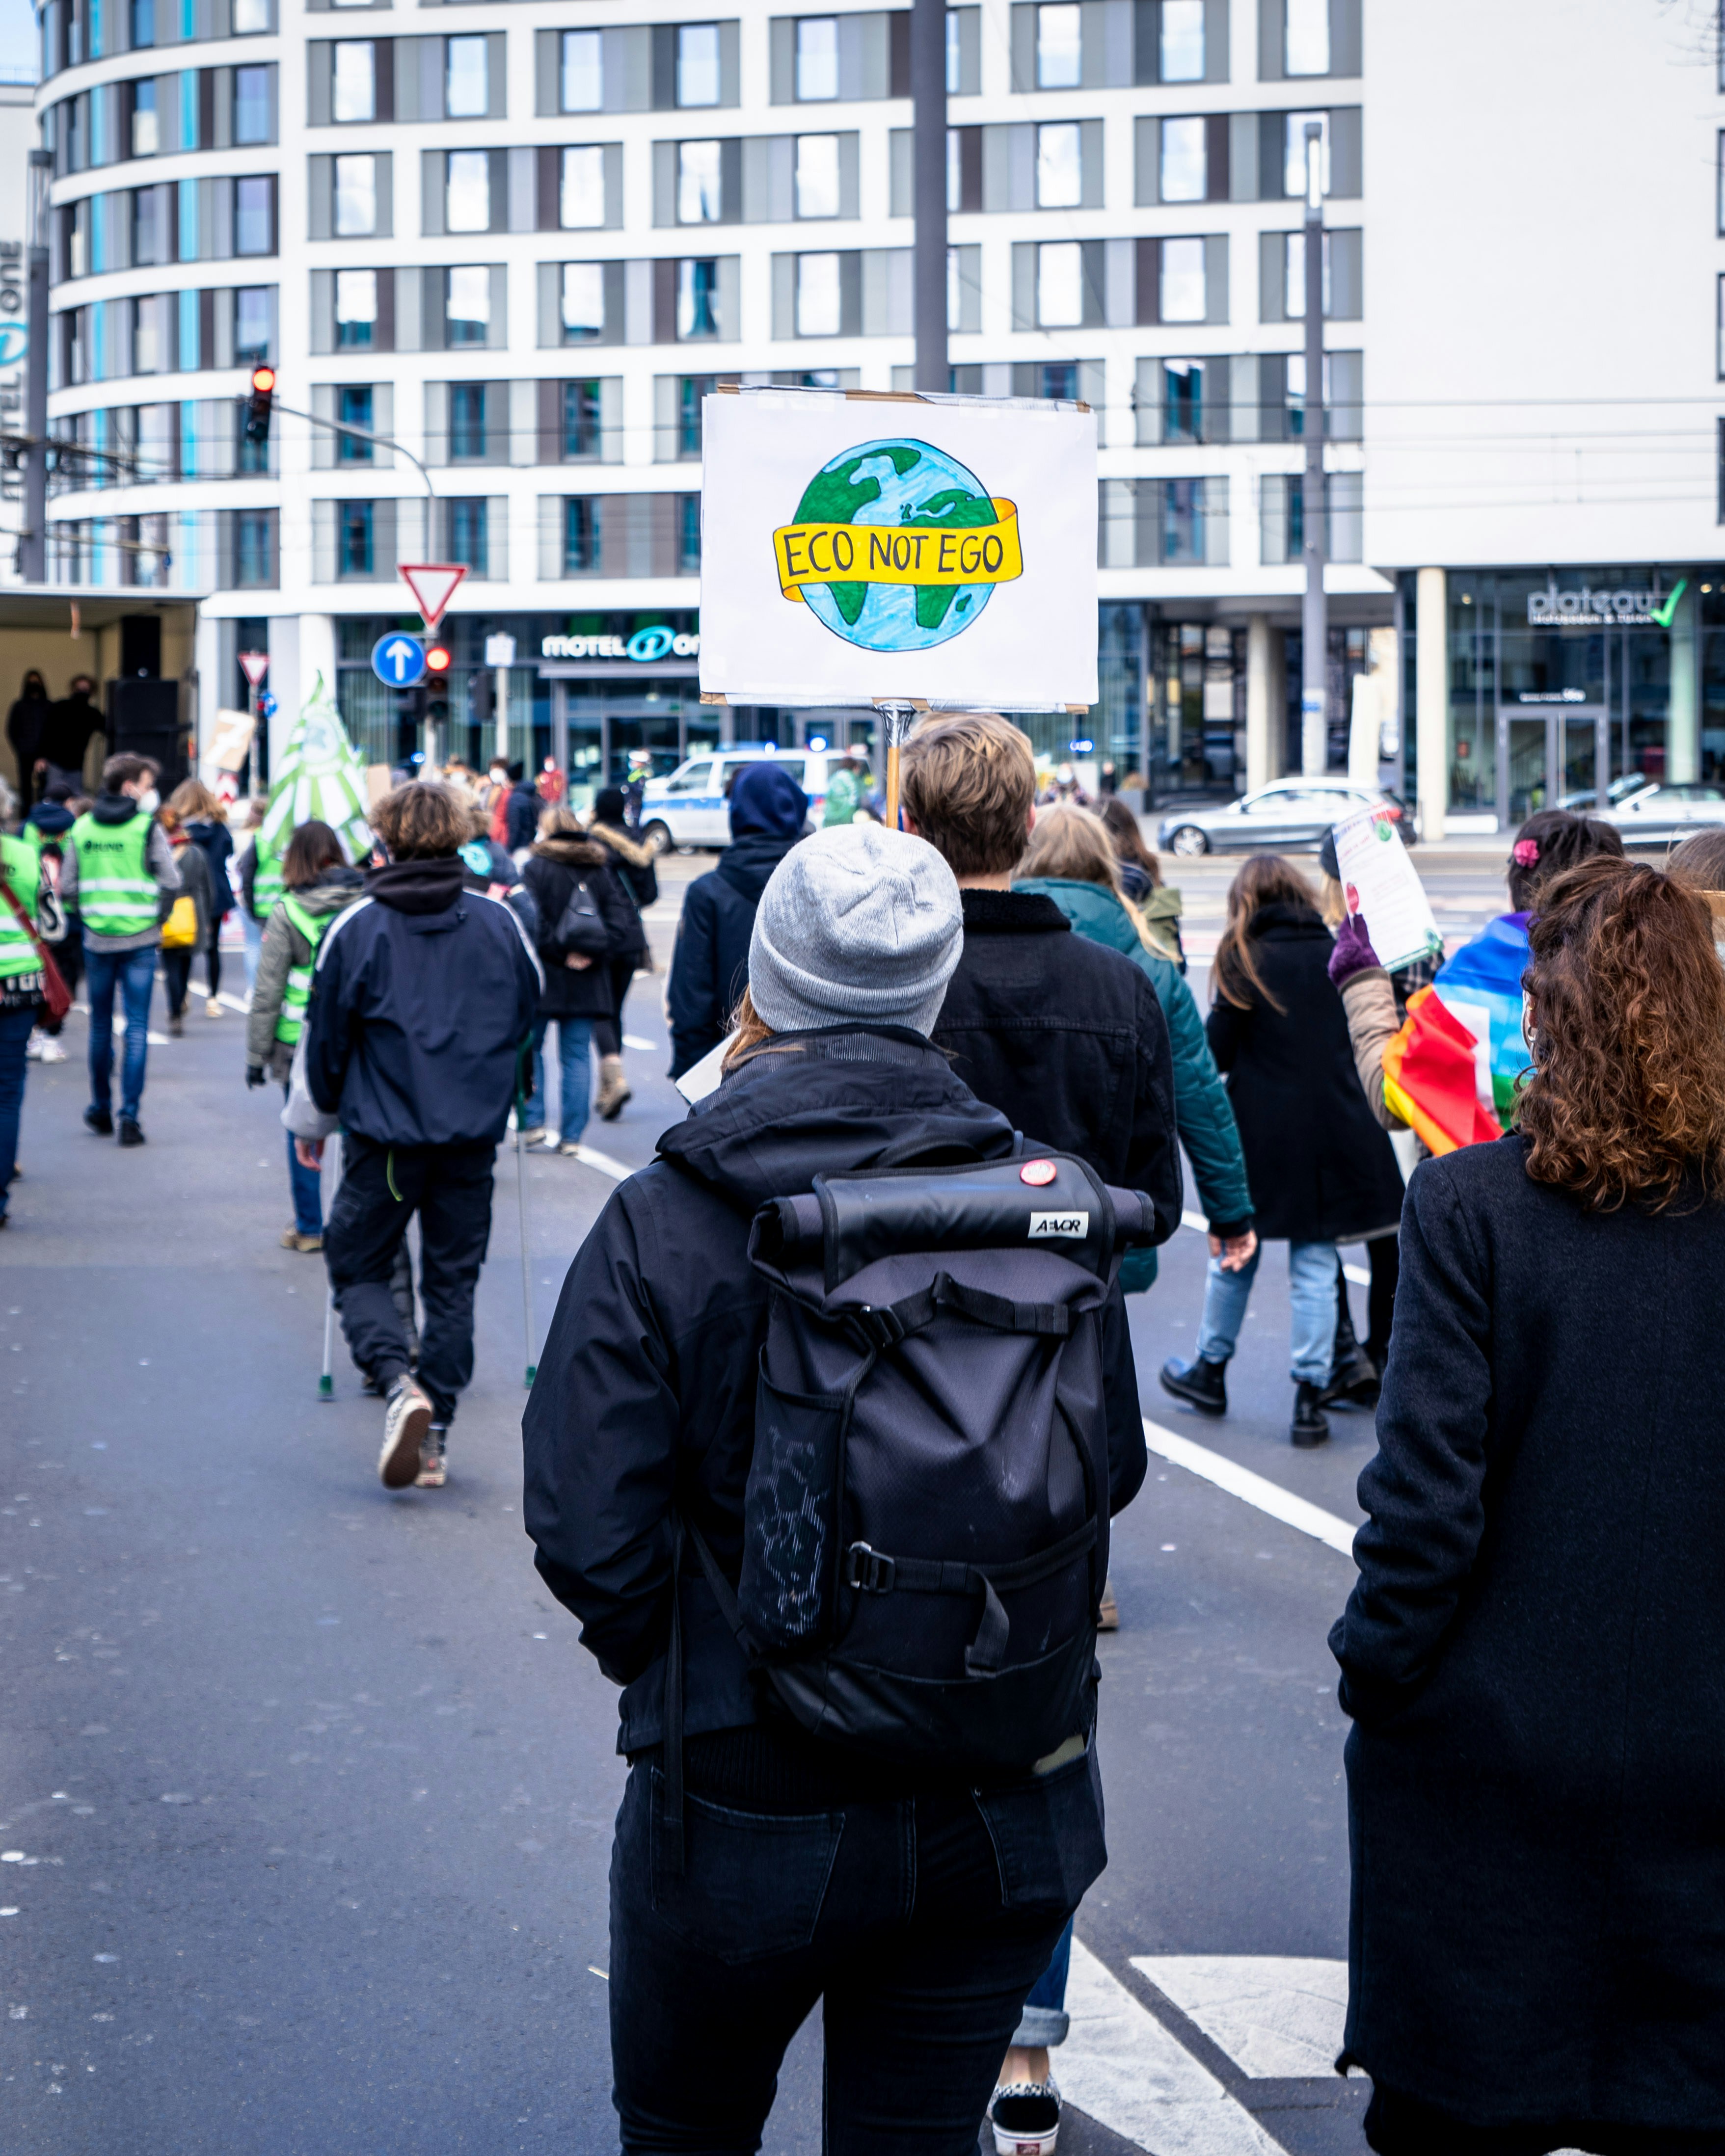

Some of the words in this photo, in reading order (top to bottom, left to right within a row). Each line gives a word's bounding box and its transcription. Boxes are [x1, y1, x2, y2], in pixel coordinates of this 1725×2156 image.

[783, 531, 854, 577] ECO
[869, 532, 929, 571] NOT
[938, 533, 1004, 574] EGO
[1527, 582, 1655, 626] plateau
[541, 634, 627, 657] MOTEL
